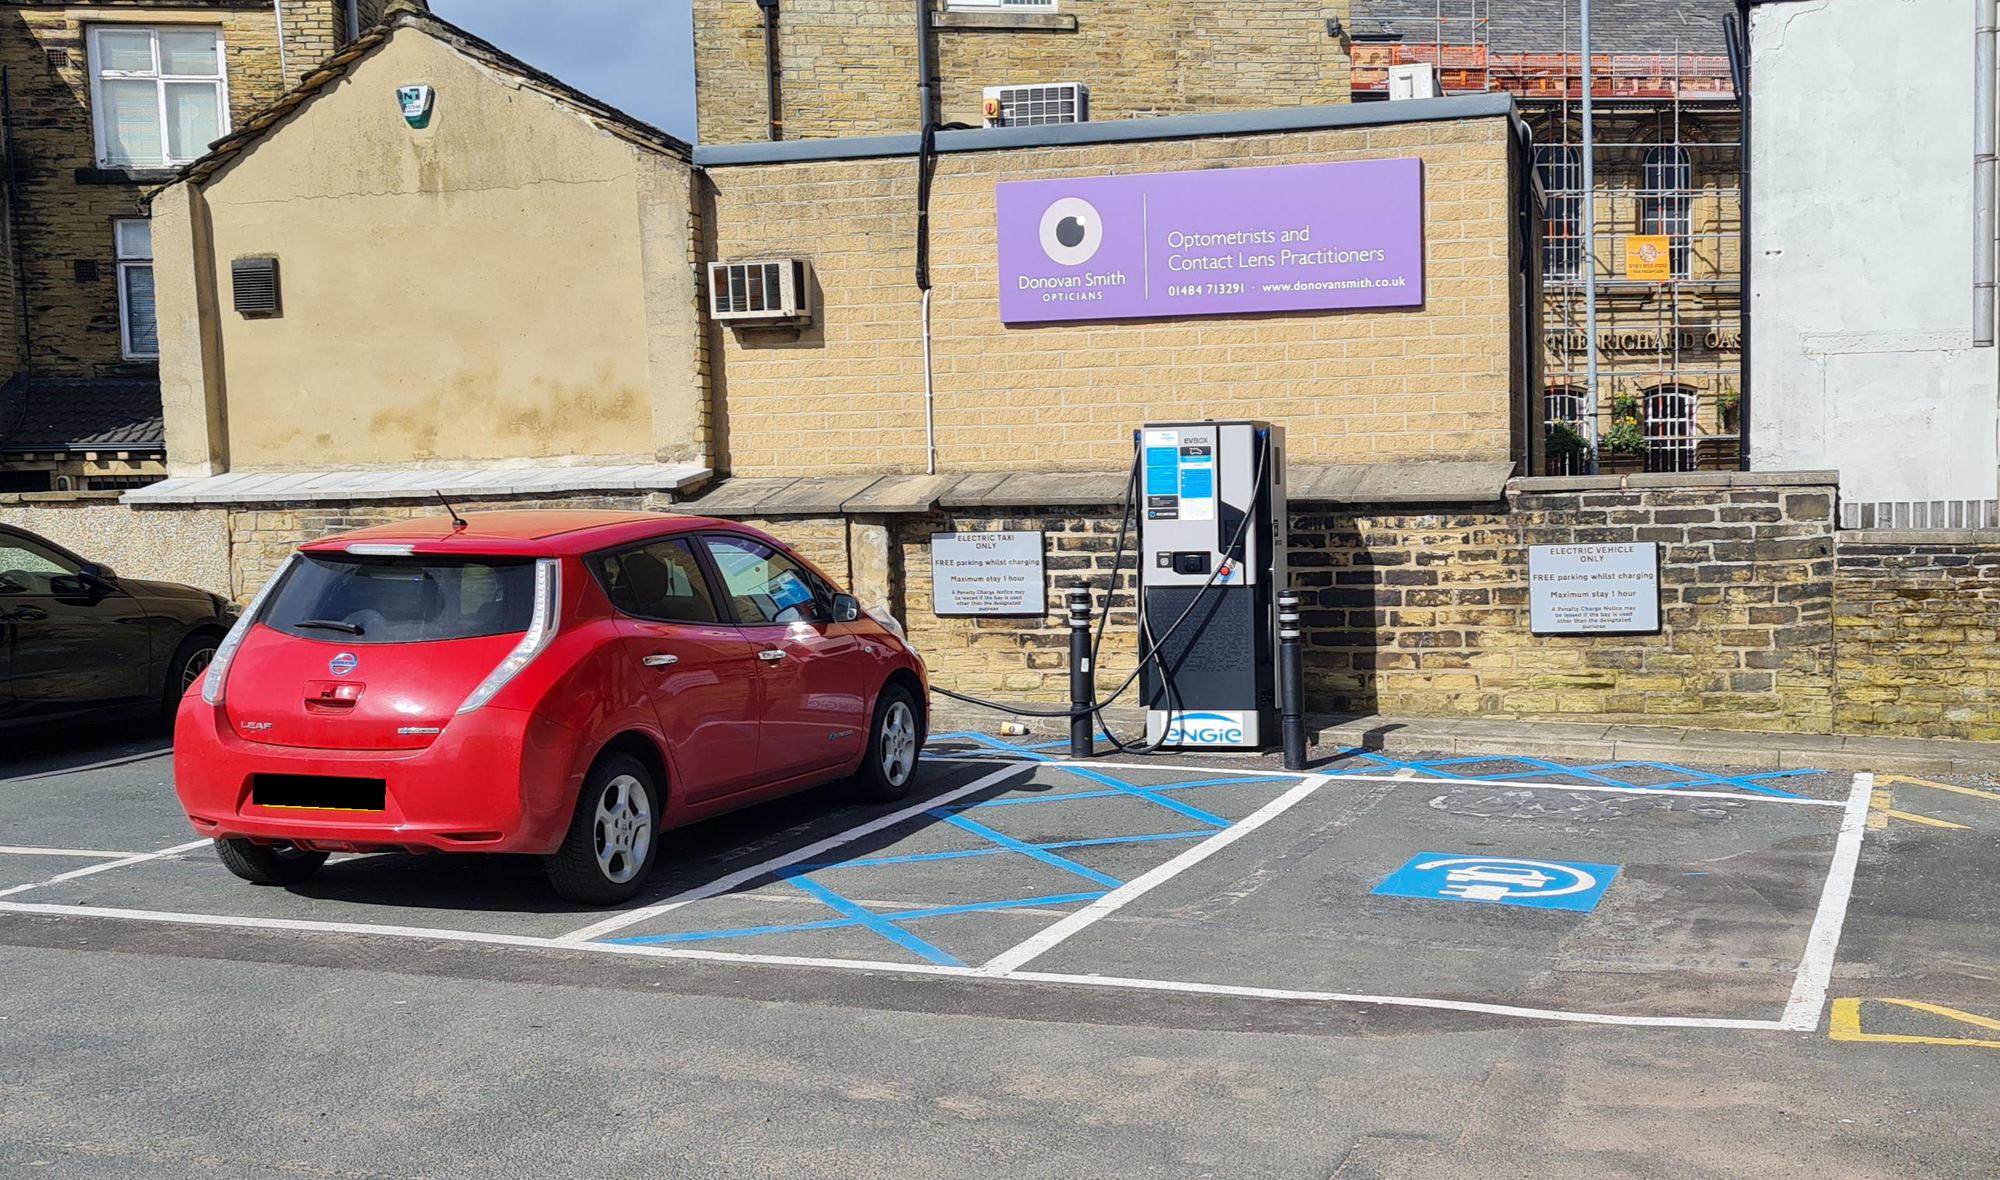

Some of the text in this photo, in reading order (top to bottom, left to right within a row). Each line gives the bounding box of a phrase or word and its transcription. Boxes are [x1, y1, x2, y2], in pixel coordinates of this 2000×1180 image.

[1167, 225, 1310, 252] Optometrists and
[1168, 247, 1385, 271] Contact Lens Practitioners
[1018, 269, 1126, 289] Donovan Smith
[1168, 275, 1406, 296] 01484 713291 www.donovansmith.co.uk
[1042, 290, 1103, 302] OPTICIANS
[1600, 332, 1695, 351] RICHARD
[957, 534, 995, 542] ELECTRIC
[1550, 546, 1634, 555] ELECTRIC VEHICLE
[1008, 559, 1040, 567] charging
[1557, 573, 1588, 581] parking
[1618, 572, 1654, 580] charging
[240, 720, 272, 729] LEAF
